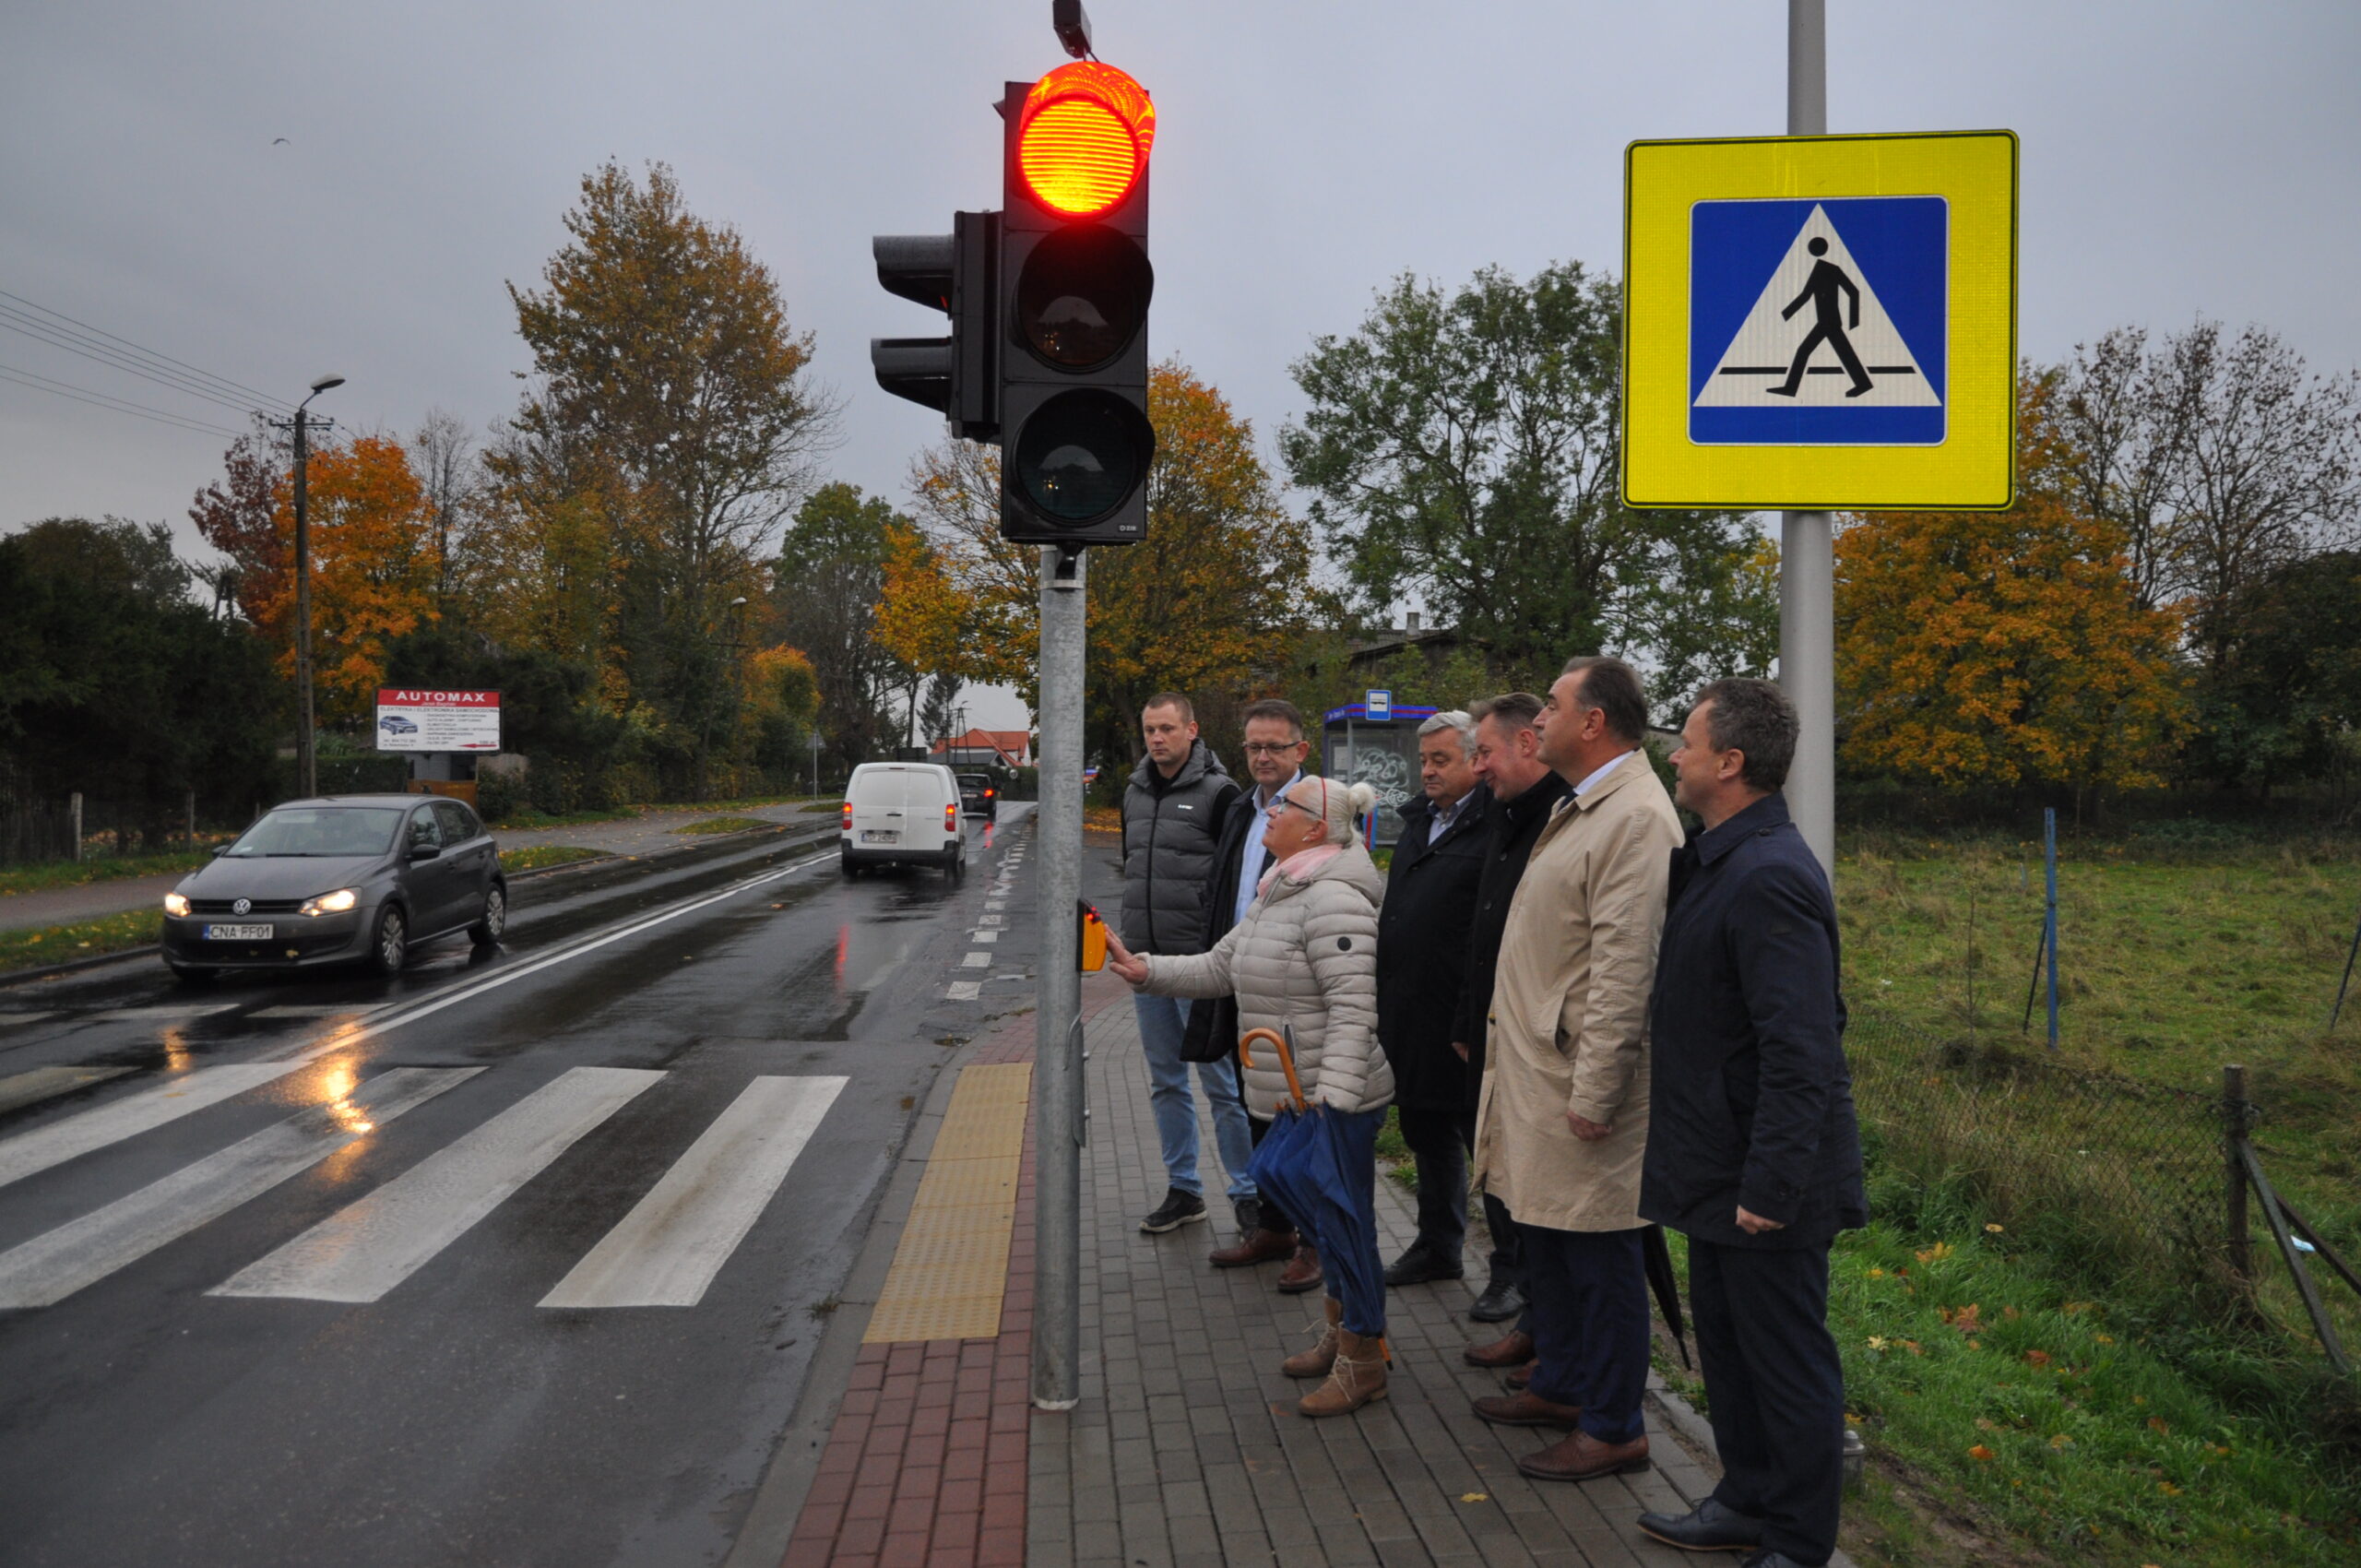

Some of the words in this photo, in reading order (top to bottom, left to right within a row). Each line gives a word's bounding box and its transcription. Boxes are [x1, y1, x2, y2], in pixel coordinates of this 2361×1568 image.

[396, 691, 485, 702] AUTOMAX
[211, 927, 237, 938] CNA
[241, 927, 270, 938] FF01
